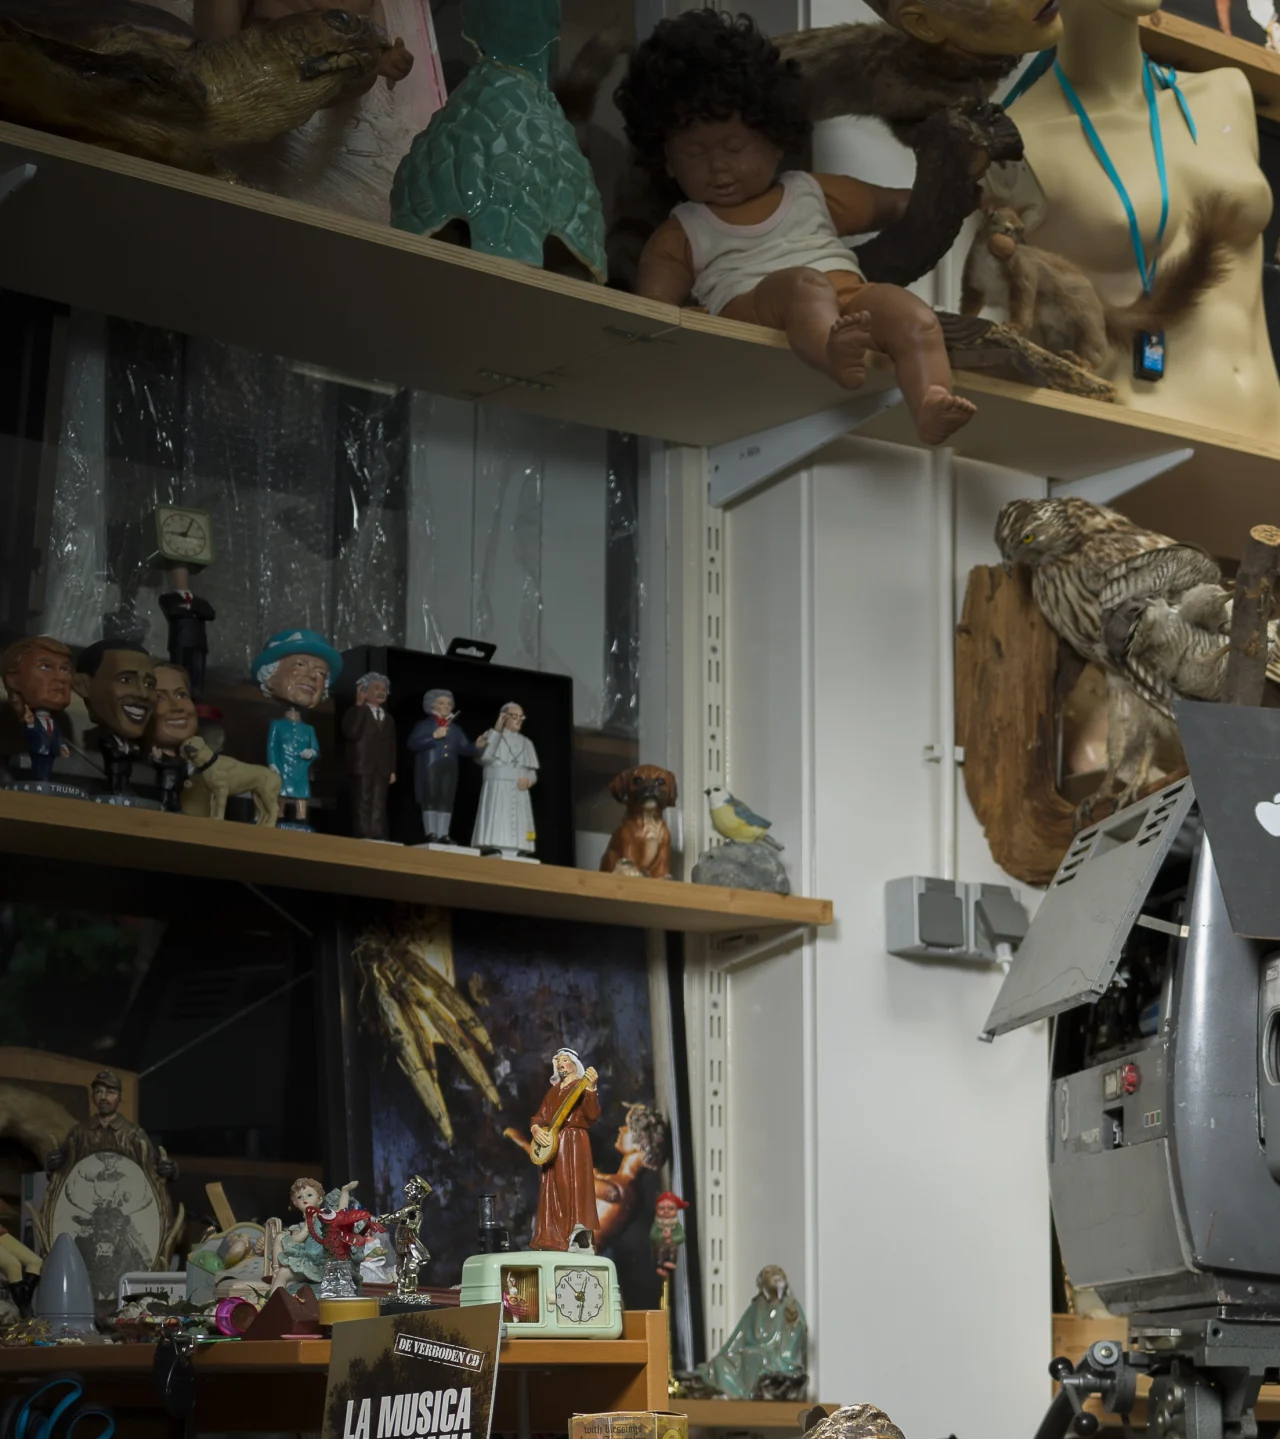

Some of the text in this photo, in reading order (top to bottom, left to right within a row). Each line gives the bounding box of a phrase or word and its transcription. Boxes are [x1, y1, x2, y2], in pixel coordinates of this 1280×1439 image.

[50, 784, 80, 796] TRUMP
[398, 1337, 480, 1367] DE VERBODEN CD
[376, 1387, 472, 1439] MUSICA
[584, 1423, 642, 1436] with blessings
